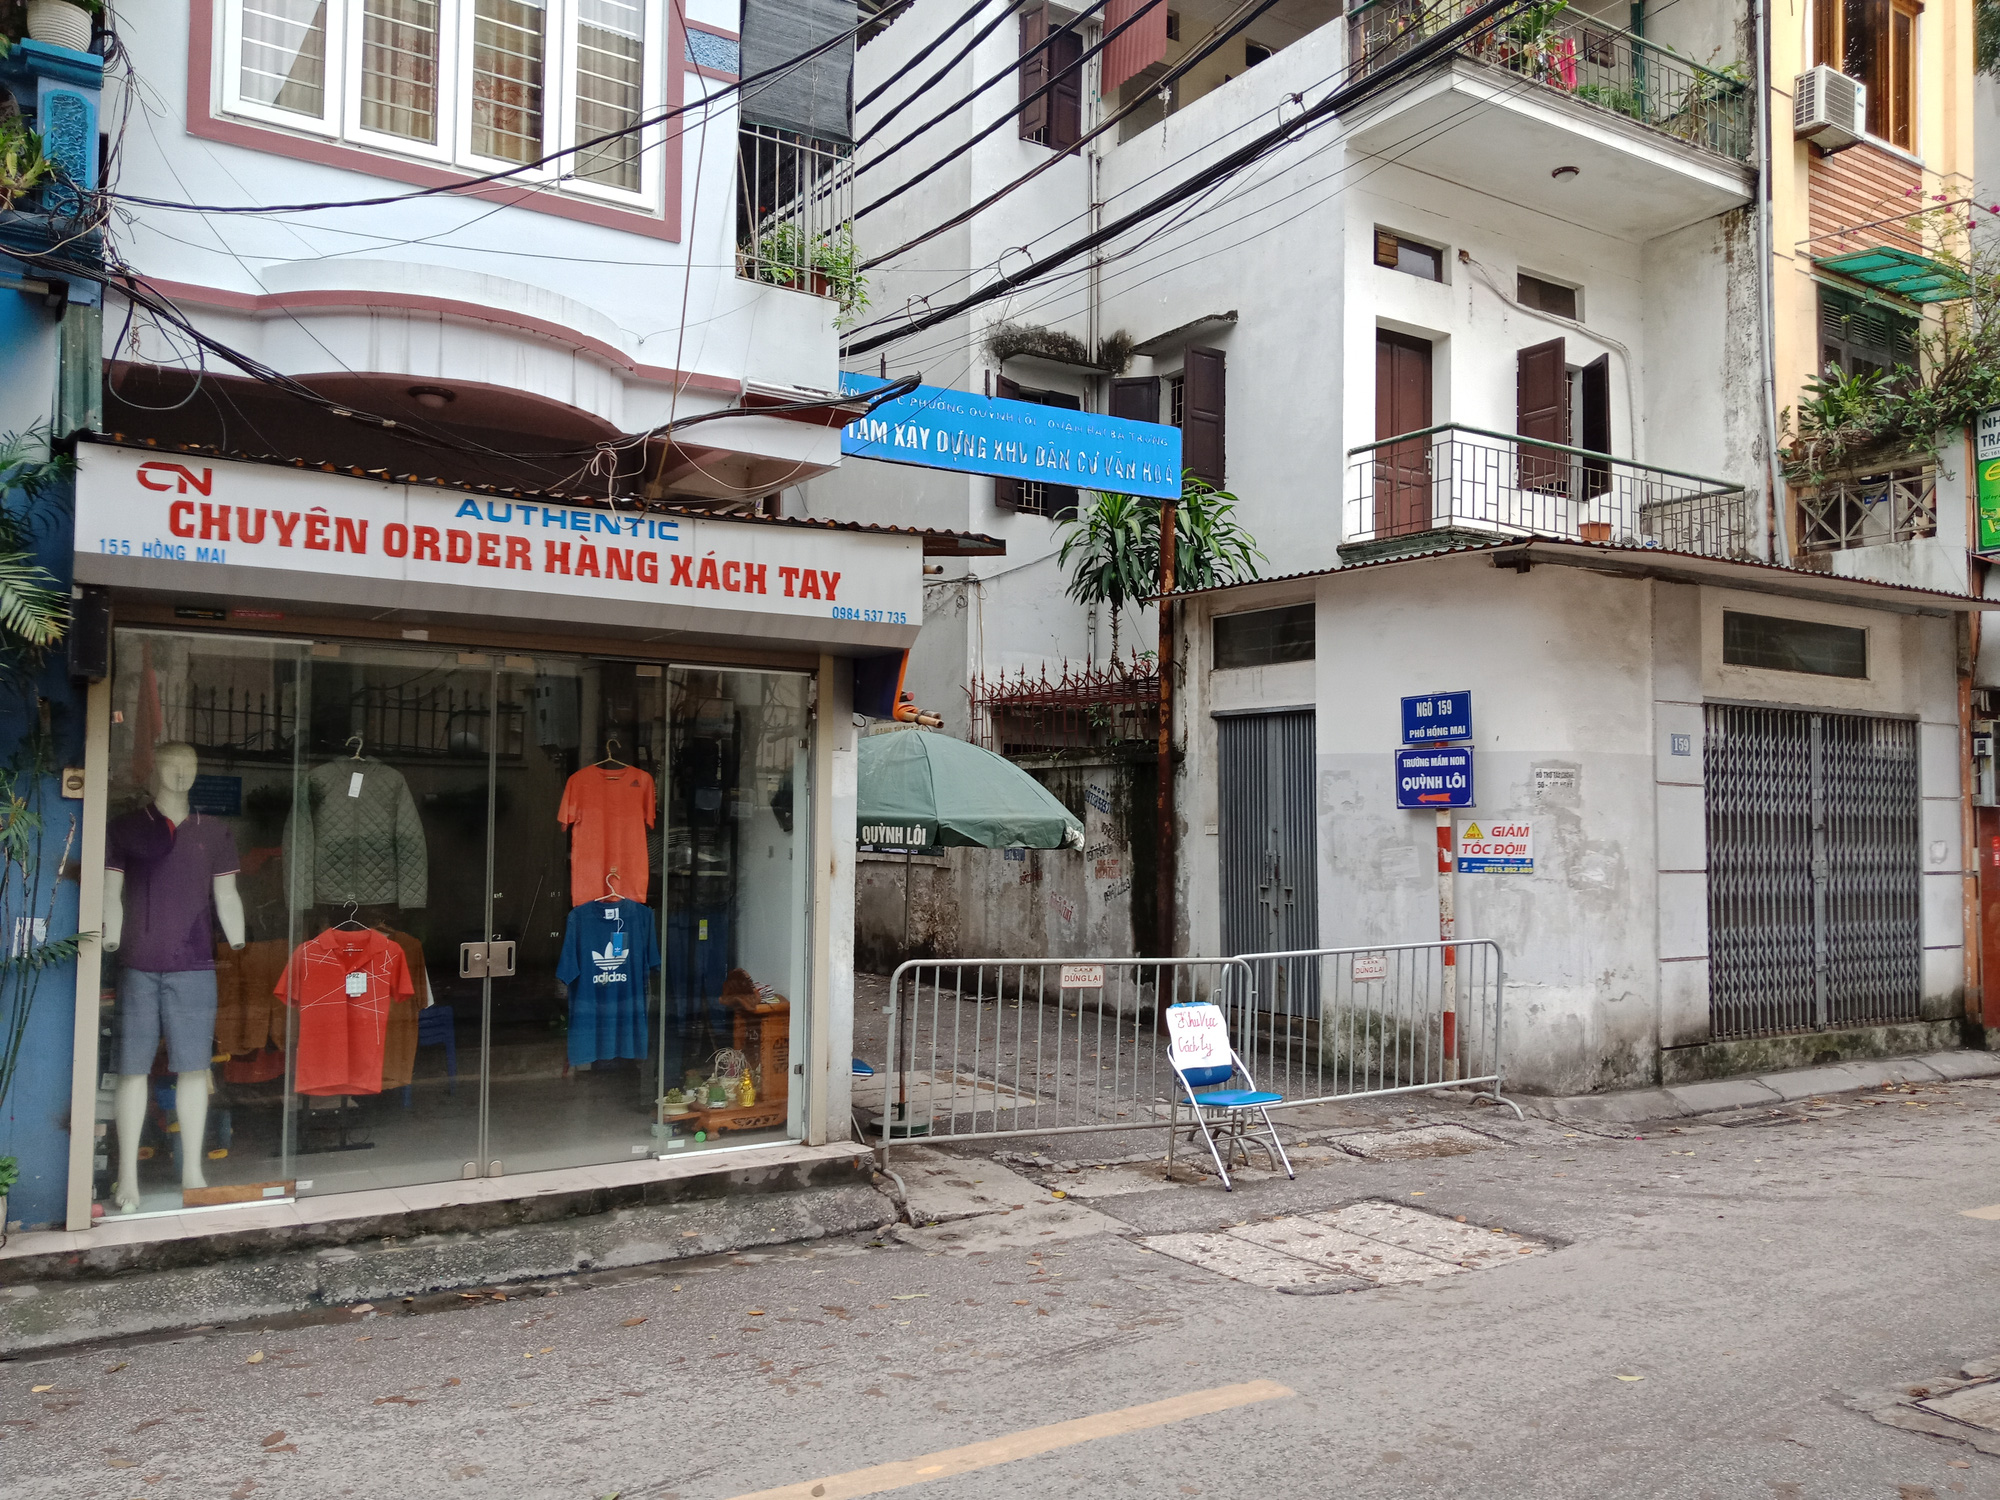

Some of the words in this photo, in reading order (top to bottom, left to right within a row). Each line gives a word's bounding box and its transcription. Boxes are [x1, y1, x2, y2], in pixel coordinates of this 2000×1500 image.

[894, 420, 930, 451] XÂY
[936, 430, 987, 462] DỰNG
[1035, 441, 1071, 471] DÂN
[1078, 450, 1100, 475] CƯ
[1105, 450, 1136, 480] VĂN
[455, 498, 679, 542] AUTHENTIC
[99, 538, 131, 556] 155
[142, 537, 186, 561] HỒNG
[196, 546, 226, 564] MAI
[169, 499, 369, 555] CHUYÊN
[382, 522, 532, 571] ORDER
[544, 534, 659, 585] HÀNG
[669, 550, 768, 596] XÁCH
[778, 565, 842, 602] TAY
[832, 606, 860, 621] 0984
[864, 609, 883, 623] 537
[887, 611, 907, 625] 735
[1437, 699, 1452, 716] 159
[1409, 725, 1426, 739] PHỐ
[1449, 725, 1466, 735] MAI
[1674, 737, 1689, 752] 159
[1402, 755, 1430, 768] TRƯỜNG
[1449, 755, 1466, 766] NON
[1402, 773, 1443, 792] QUỲNH
[1445, 771, 1466, 789] LÔI
[862, 822, 904, 845] QUỲNH
[906, 824, 927, 845] LÔI
[1491, 823, 1530, 838] GIẢM
[1462, 839, 1492, 855] TỐC
[1493, 841, 1527, 857] ĐỘ!!!
[592, 971, 628, 984] adidas
